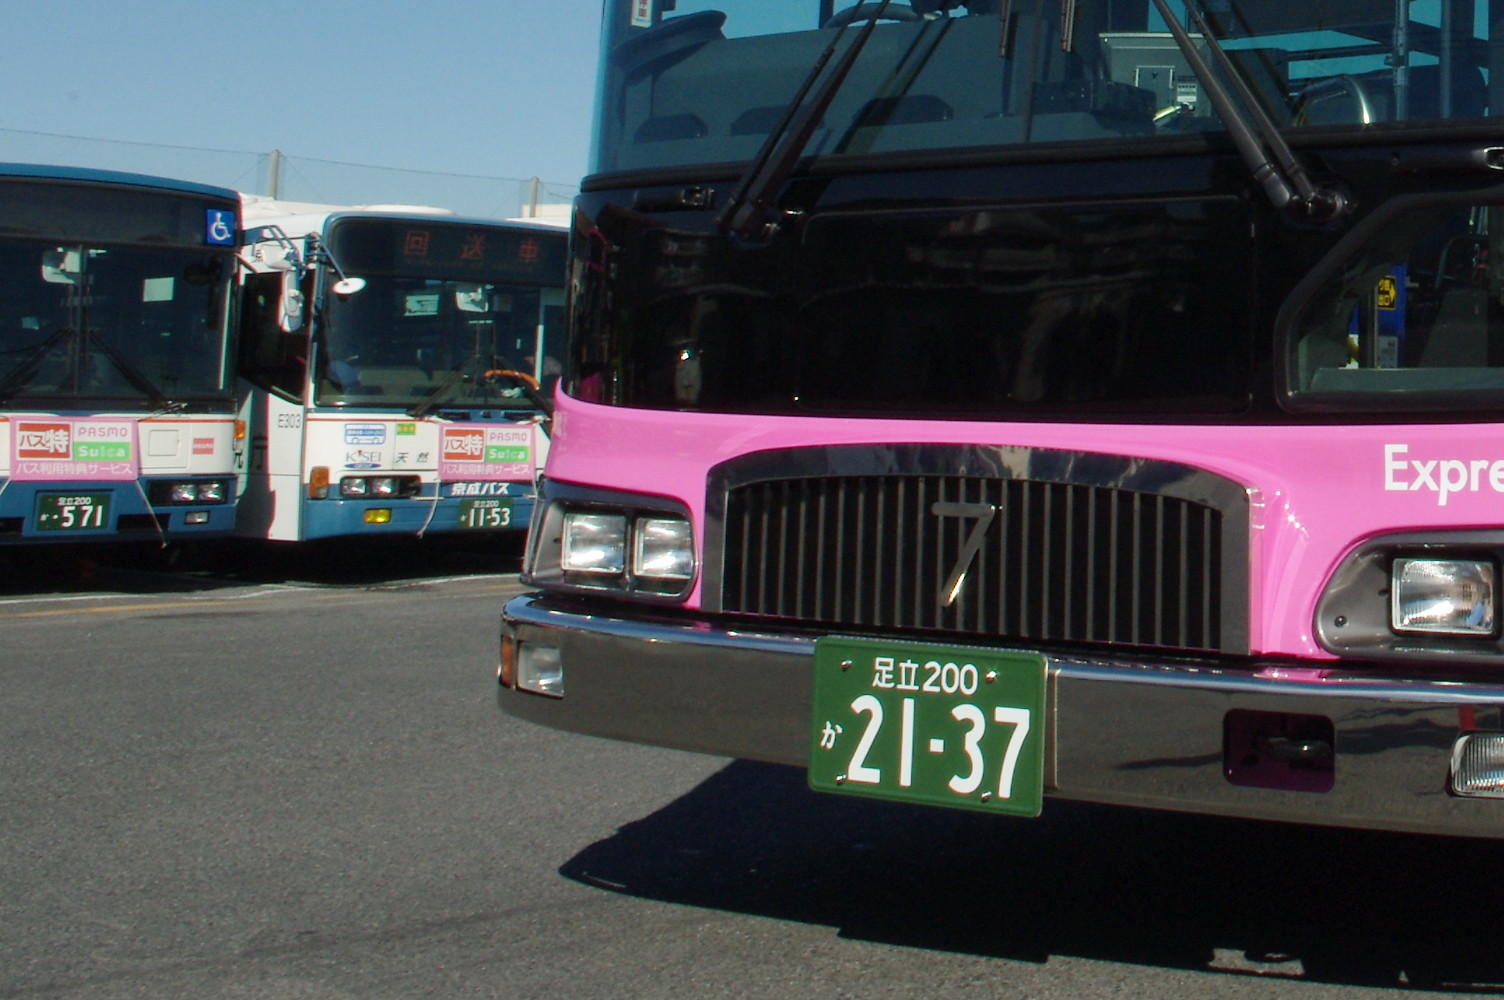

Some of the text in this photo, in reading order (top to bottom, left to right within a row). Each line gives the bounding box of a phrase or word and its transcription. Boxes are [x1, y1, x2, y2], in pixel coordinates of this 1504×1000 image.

[278, 413, 301, 429] E303
[77, 426, 129, 438] PASMO
[489, 431, 528, 443] PASMO
[18, 428, 70, 454] バス特
[444, 434, 483, 457] バス特
[78, 445, 127, 458] Suica
[489, 448, 526, 460] Suica
[15, 463, 133, 475] バス利用特典サービス
[451, 481, 510, 496] 京成バス
[467, 507, 511, 527] 11-53
[931, 501, 996, 607] 7
[871, 656, 979, 696] 足立200
[820, 694, 1031, 800] か 21-37
